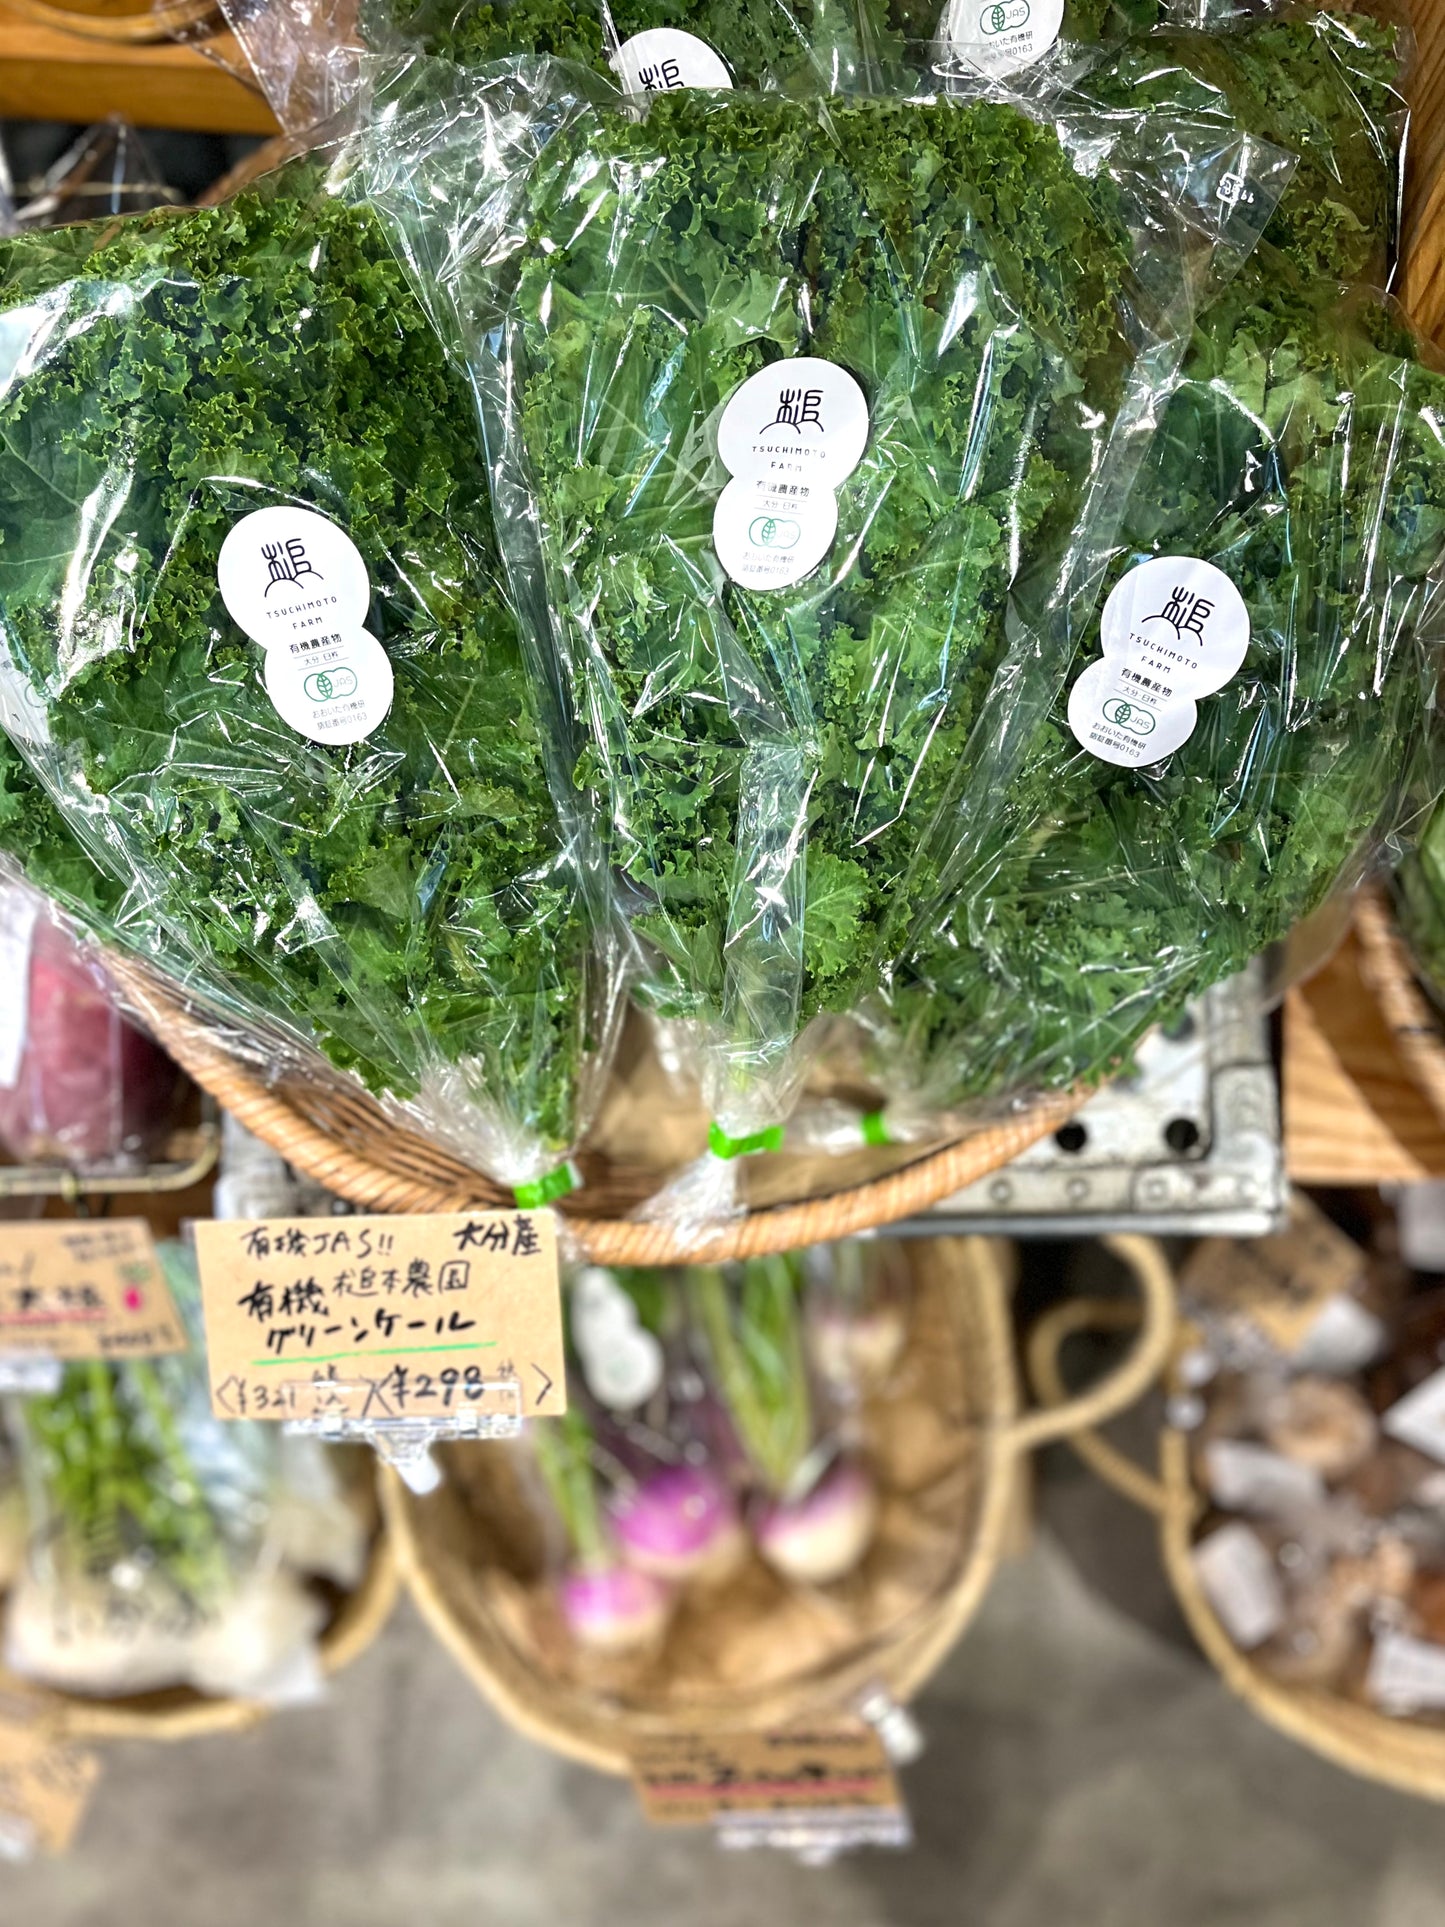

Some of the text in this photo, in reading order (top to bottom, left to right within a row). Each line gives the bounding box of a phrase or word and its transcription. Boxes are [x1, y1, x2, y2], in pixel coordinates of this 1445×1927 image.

[1006, 7, 1027, 19] JAS
[752, 445, 826, 459] TSUCHIMOTO
[266, 595, 338, 620] TSUCHIMOTO
[292, 616, 324, 631] FARM
[289, 633, 343, 654] 有機農産物
[1129, 632, 1199, 670] TSUCHIMOTO
[1140, 655, 1172, 674] FARM
[333, 675, 354, 688] JAS
[1121, 667, 1174, 698] 有機農産物
[1129, 715, 1152, 730] JAS
[1091, 722, 1147, 751] おおいた有機研
[453, 1214, 542, 1257] 大分産
[237, 1275, 330, 1324] 有機
[266, 1307, 477, 1355] グリーンケール
